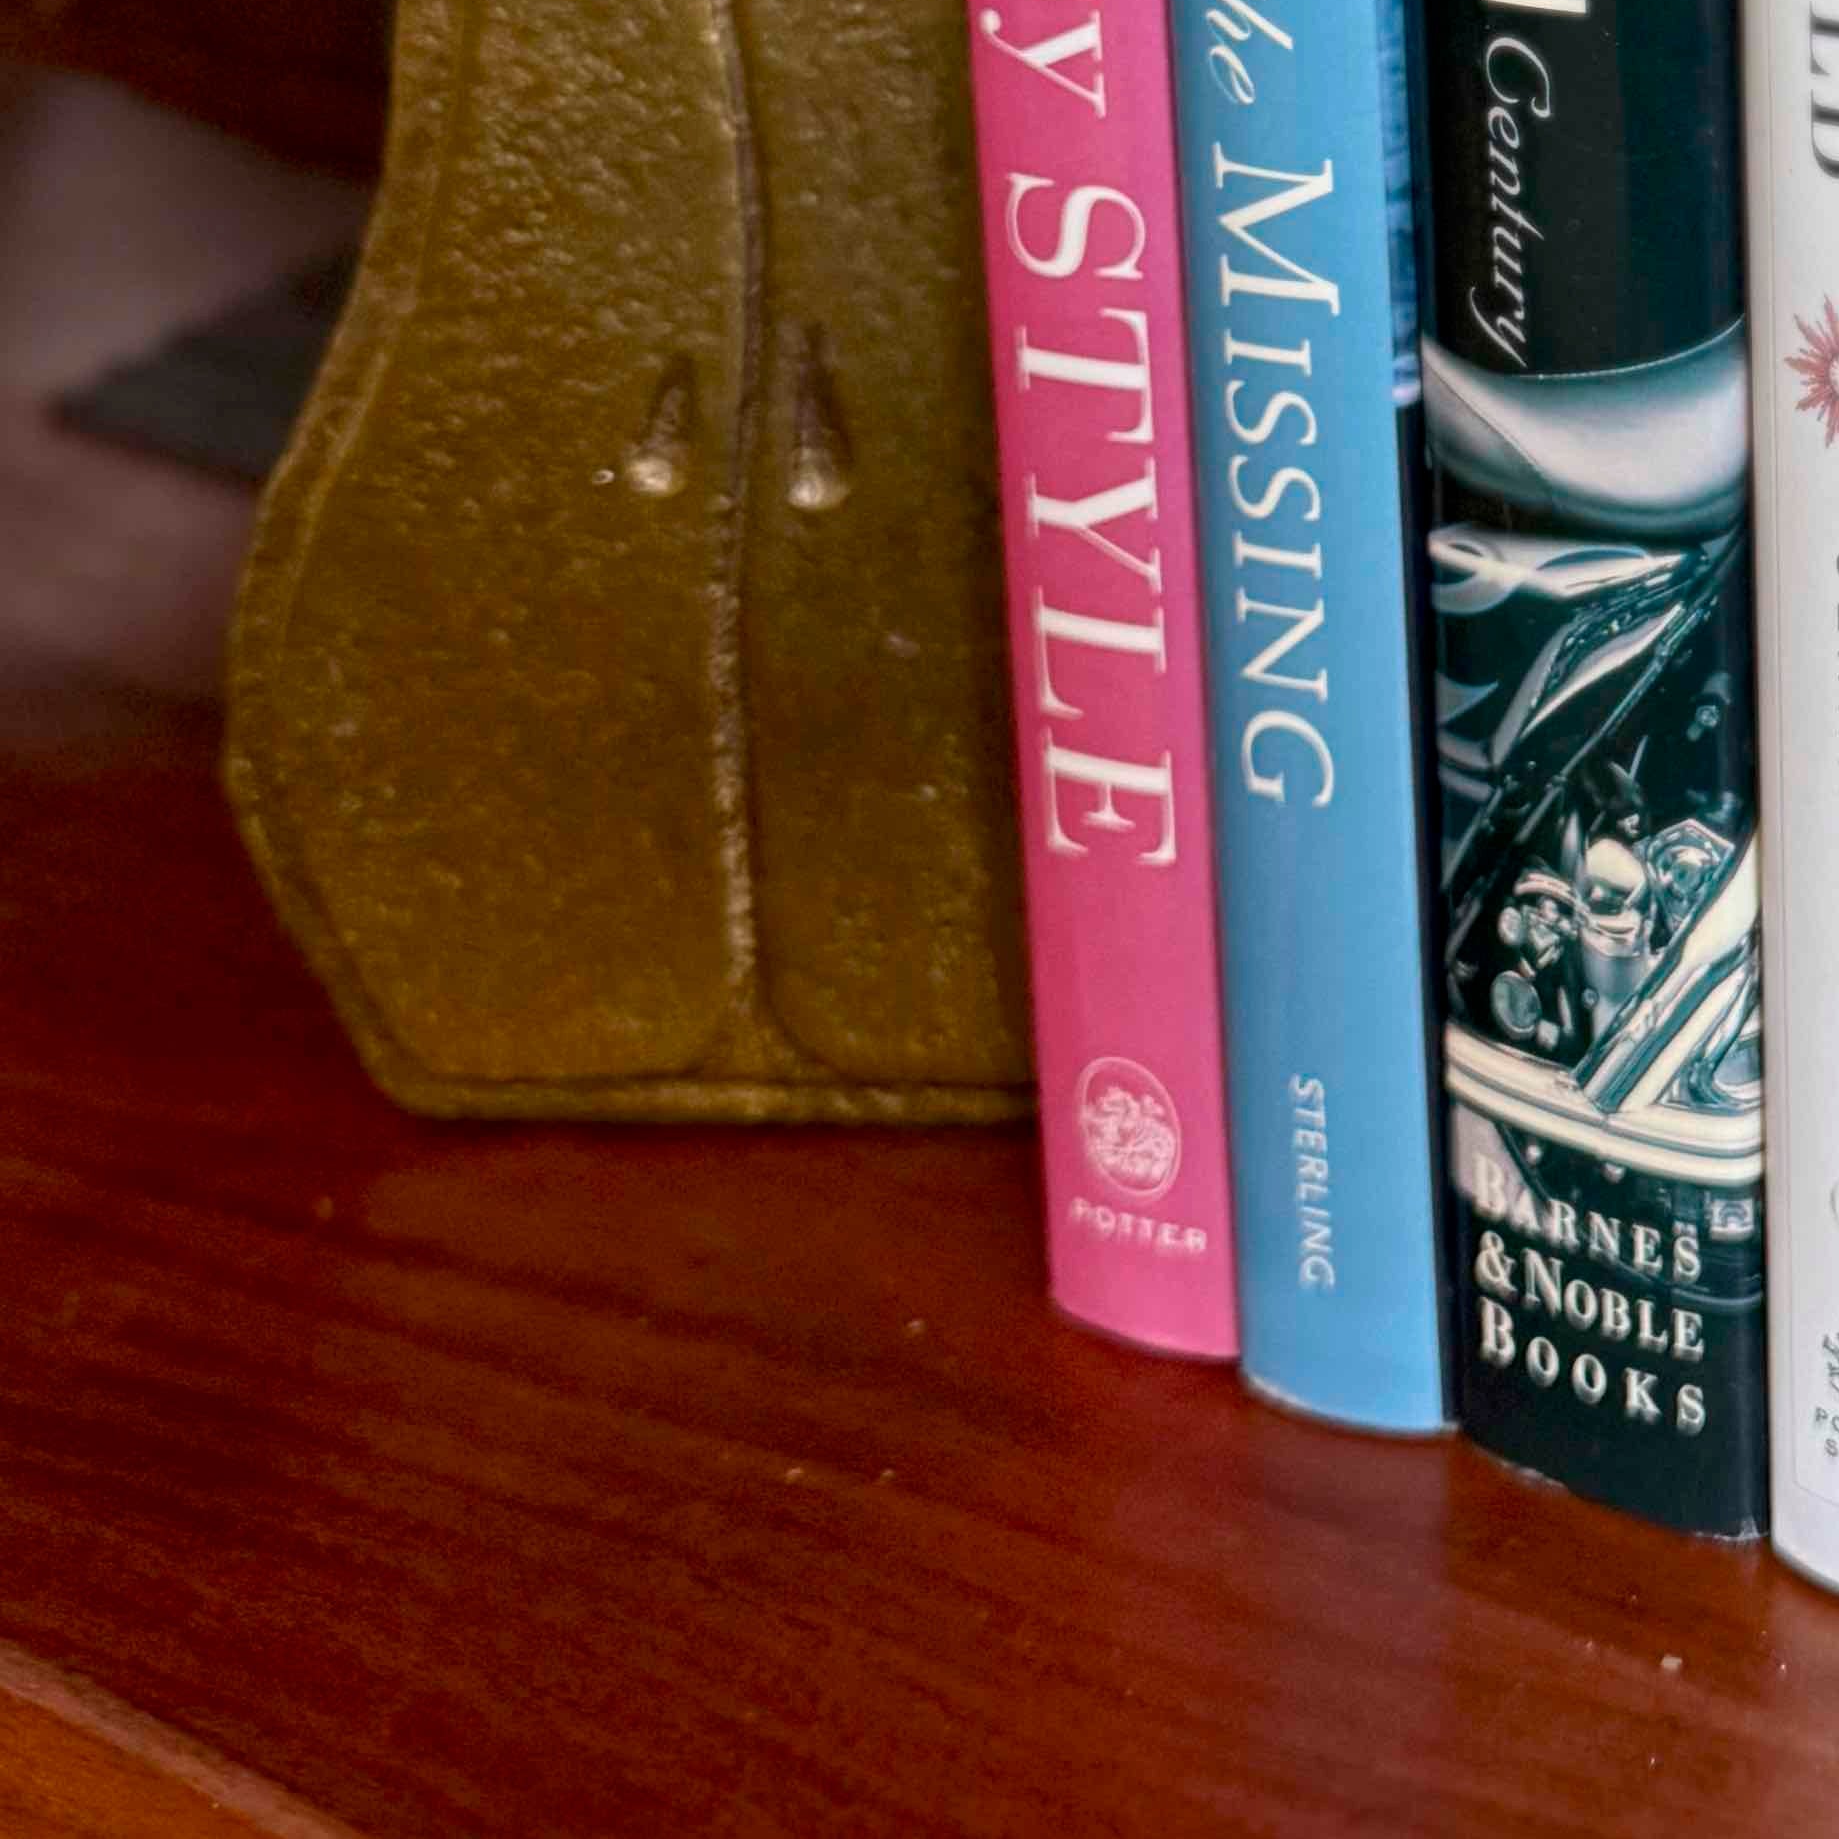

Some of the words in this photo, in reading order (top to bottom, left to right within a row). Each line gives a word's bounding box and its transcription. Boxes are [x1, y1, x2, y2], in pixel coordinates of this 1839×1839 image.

[1469, 35, 1551, 369] Century
[1005, 171, 1178, 867] STYLE
[1211, 141, 1340, 807] MISSING
[1070, 1196, 1208, 1254] POTTER
[1289, 1073, 1335, 1288] STERLING
[1472, 1153, 1701, 1284] BARNES
[1480, 1294, 1706, 1435] BOOKS
